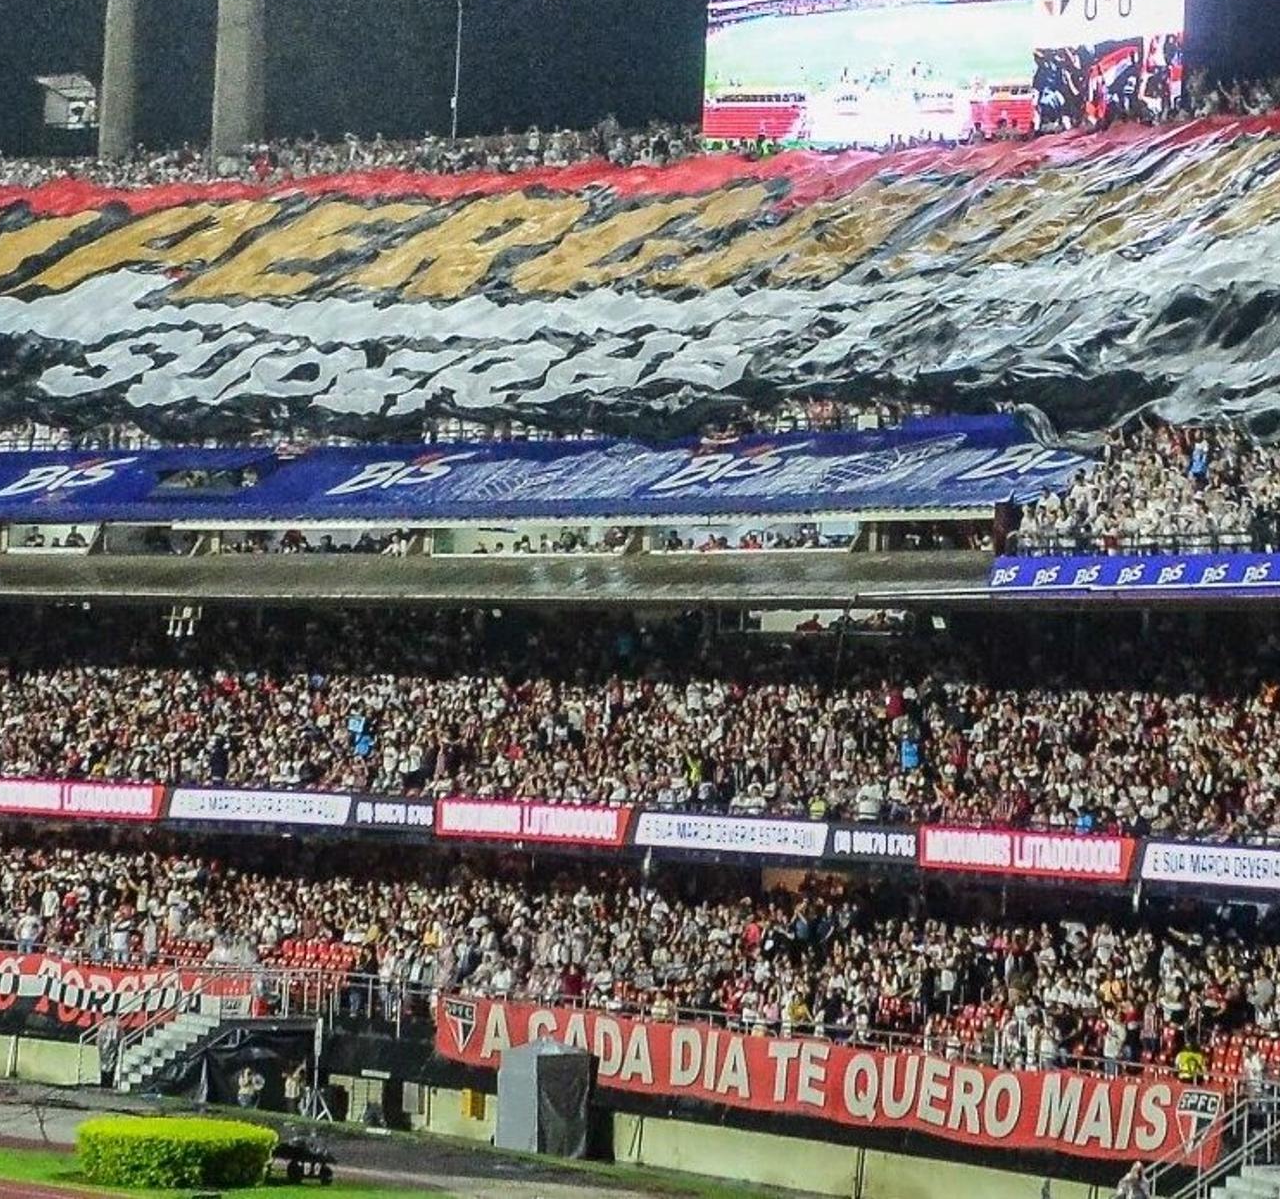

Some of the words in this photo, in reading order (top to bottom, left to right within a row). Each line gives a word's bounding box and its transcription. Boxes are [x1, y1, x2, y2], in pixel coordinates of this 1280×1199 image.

[481, 1004, 512, 1058] A
[670, 1026, 751, 1099] DIA
[768, 1040, 830, 1107] TE
[844, 1053, 1020, 1139] QUERO
[1036, 1072, 1171, 1152] MAIS
